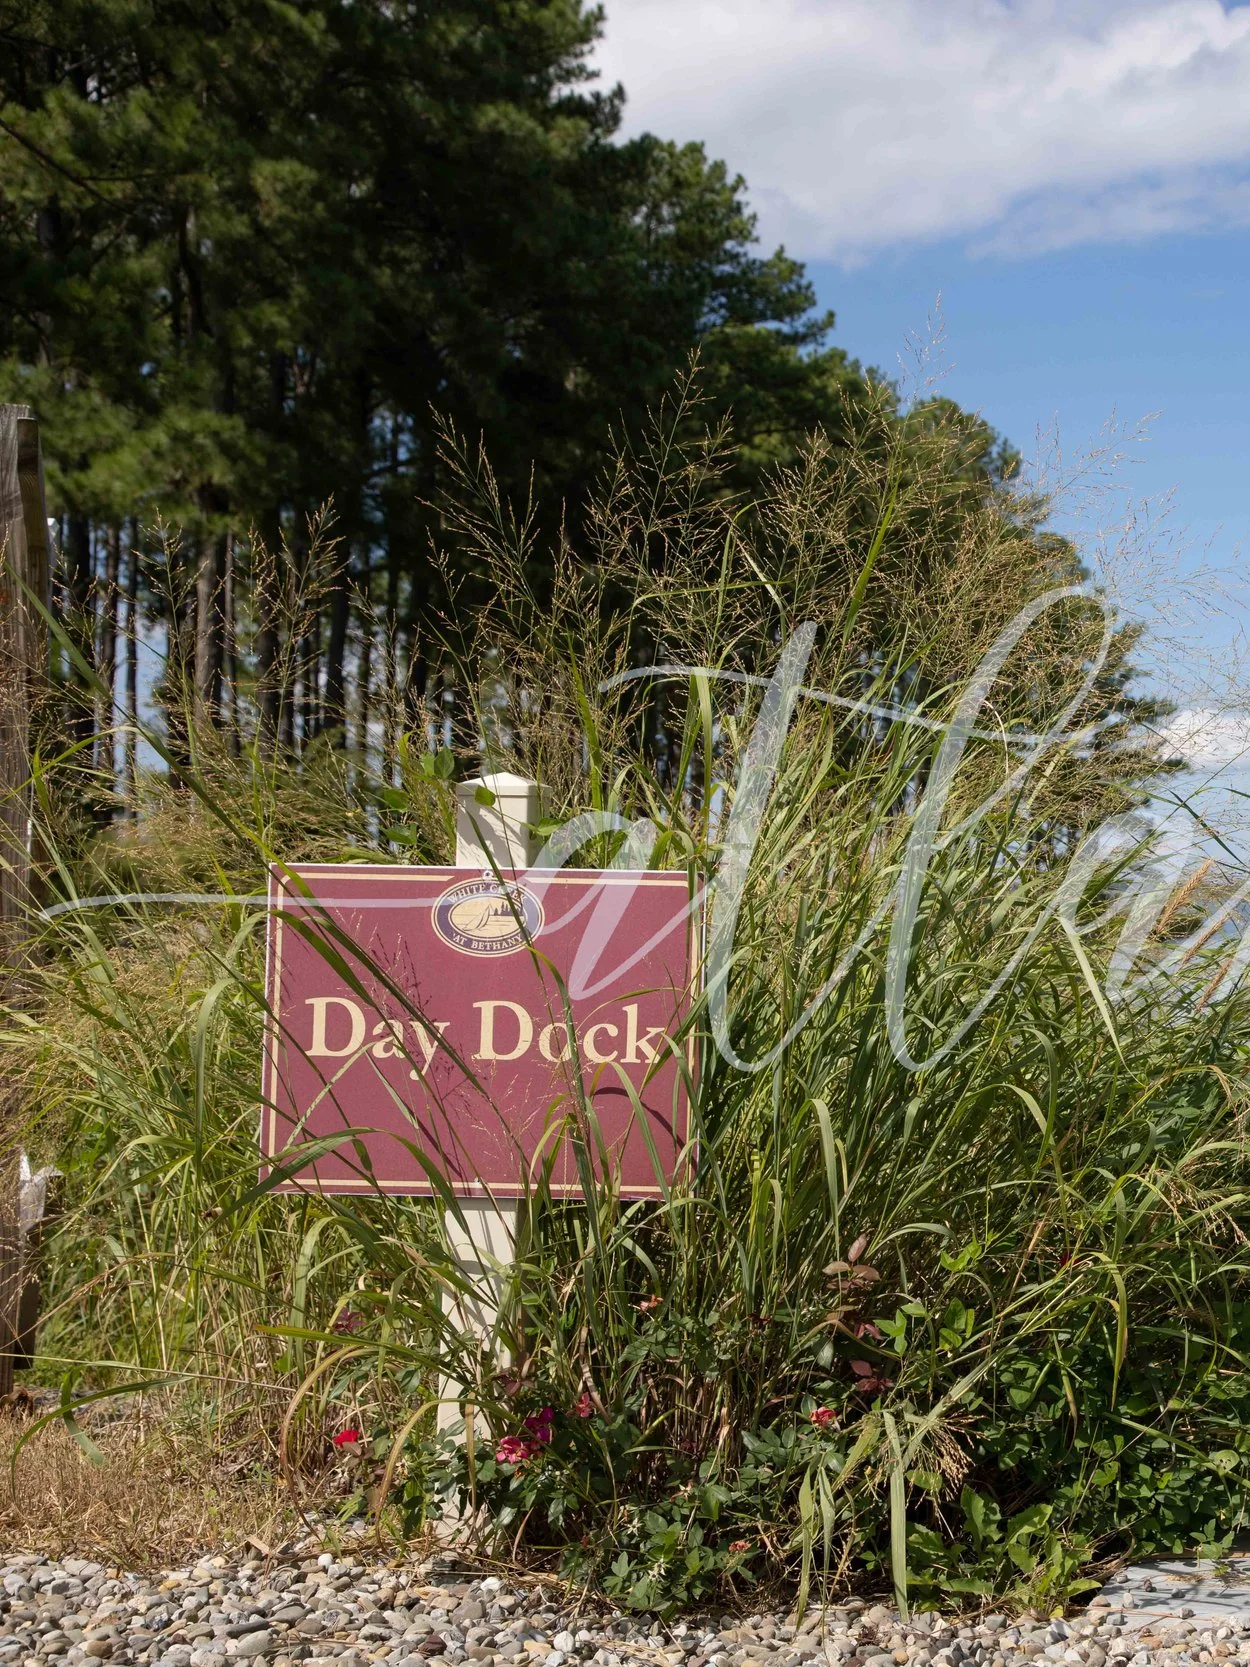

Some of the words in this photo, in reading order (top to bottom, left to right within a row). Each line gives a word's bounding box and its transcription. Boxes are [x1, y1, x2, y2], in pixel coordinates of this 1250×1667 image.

[448, 884, 487, 904] WHITE
[471, 933, 523, 951] BETHANY
[304, 996, 450, 1080] Day
[471, 1000, 667, 1065] Dock
